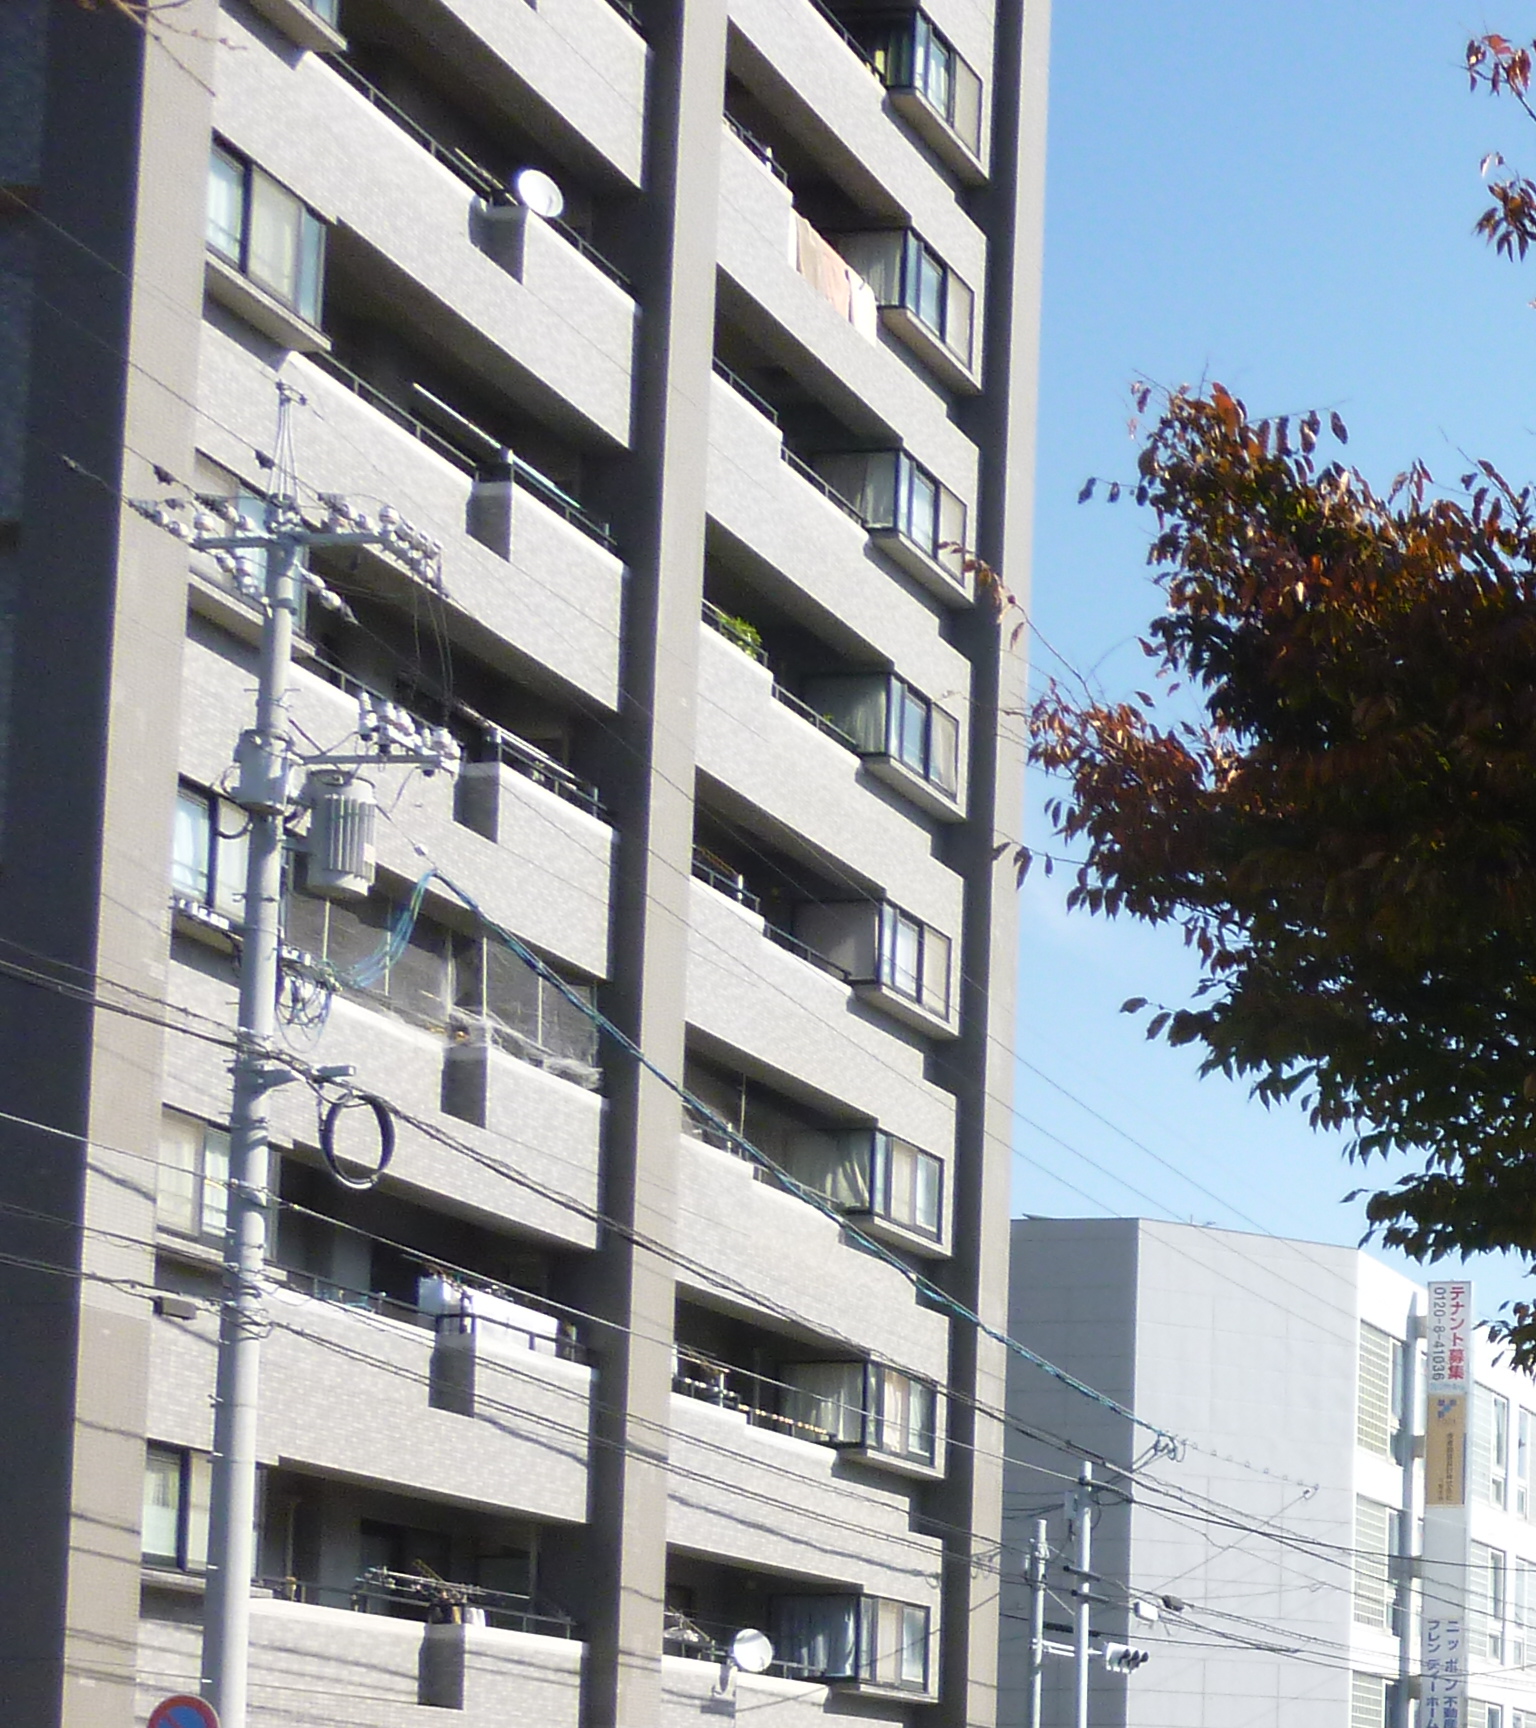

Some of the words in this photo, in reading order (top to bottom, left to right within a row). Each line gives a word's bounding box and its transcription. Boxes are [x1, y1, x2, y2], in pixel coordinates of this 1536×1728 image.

[1432, 1286, 1447, 1381] 0120-8-41036
[1447, 1286, 1466, 1381] テナント募集
